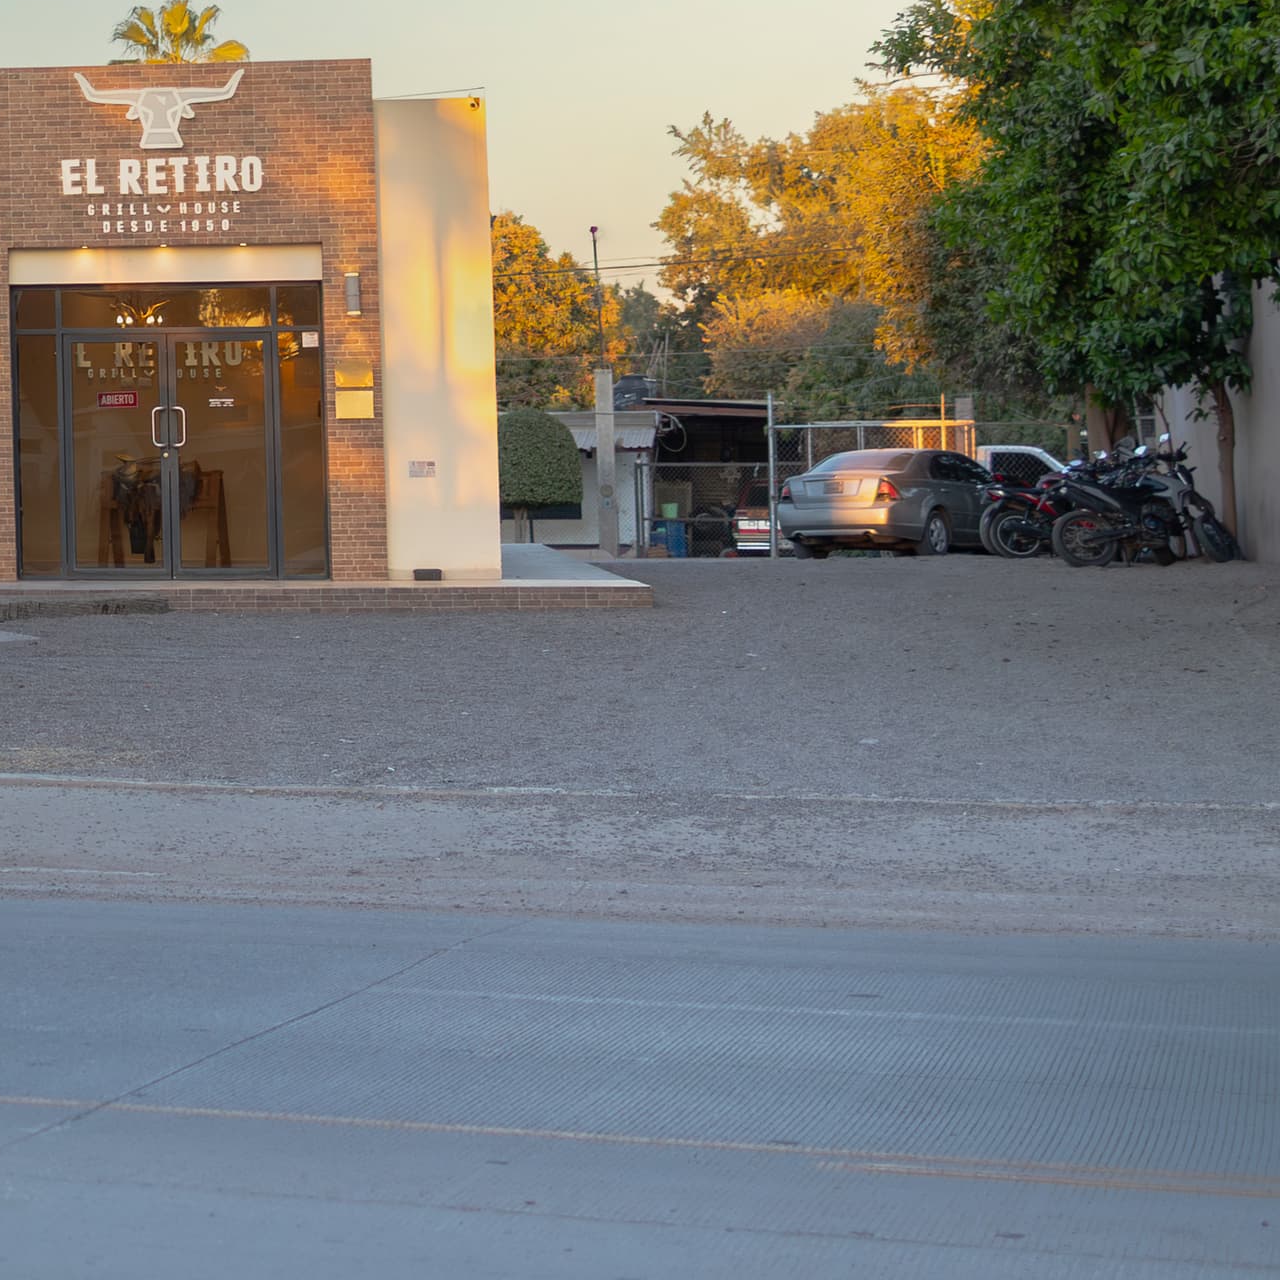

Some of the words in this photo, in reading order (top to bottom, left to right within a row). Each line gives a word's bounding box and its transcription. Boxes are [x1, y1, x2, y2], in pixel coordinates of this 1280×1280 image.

[60, 158, 105, 195] EL
[118, 155, 264, 195] RETIRO
[87, 203, 150, 216] GRILL
[179, 200, 240, 214] HOUSE
[102, 220, 168, 233] DESDE
[180, 219, 230, 232] 1950
[114, 342, 243, 368] REIRO
[87, 368, 138, 379] GRILL
[176, 367, 222, 379] OUSE
[100, 394, 135, 406] ABIERTO
